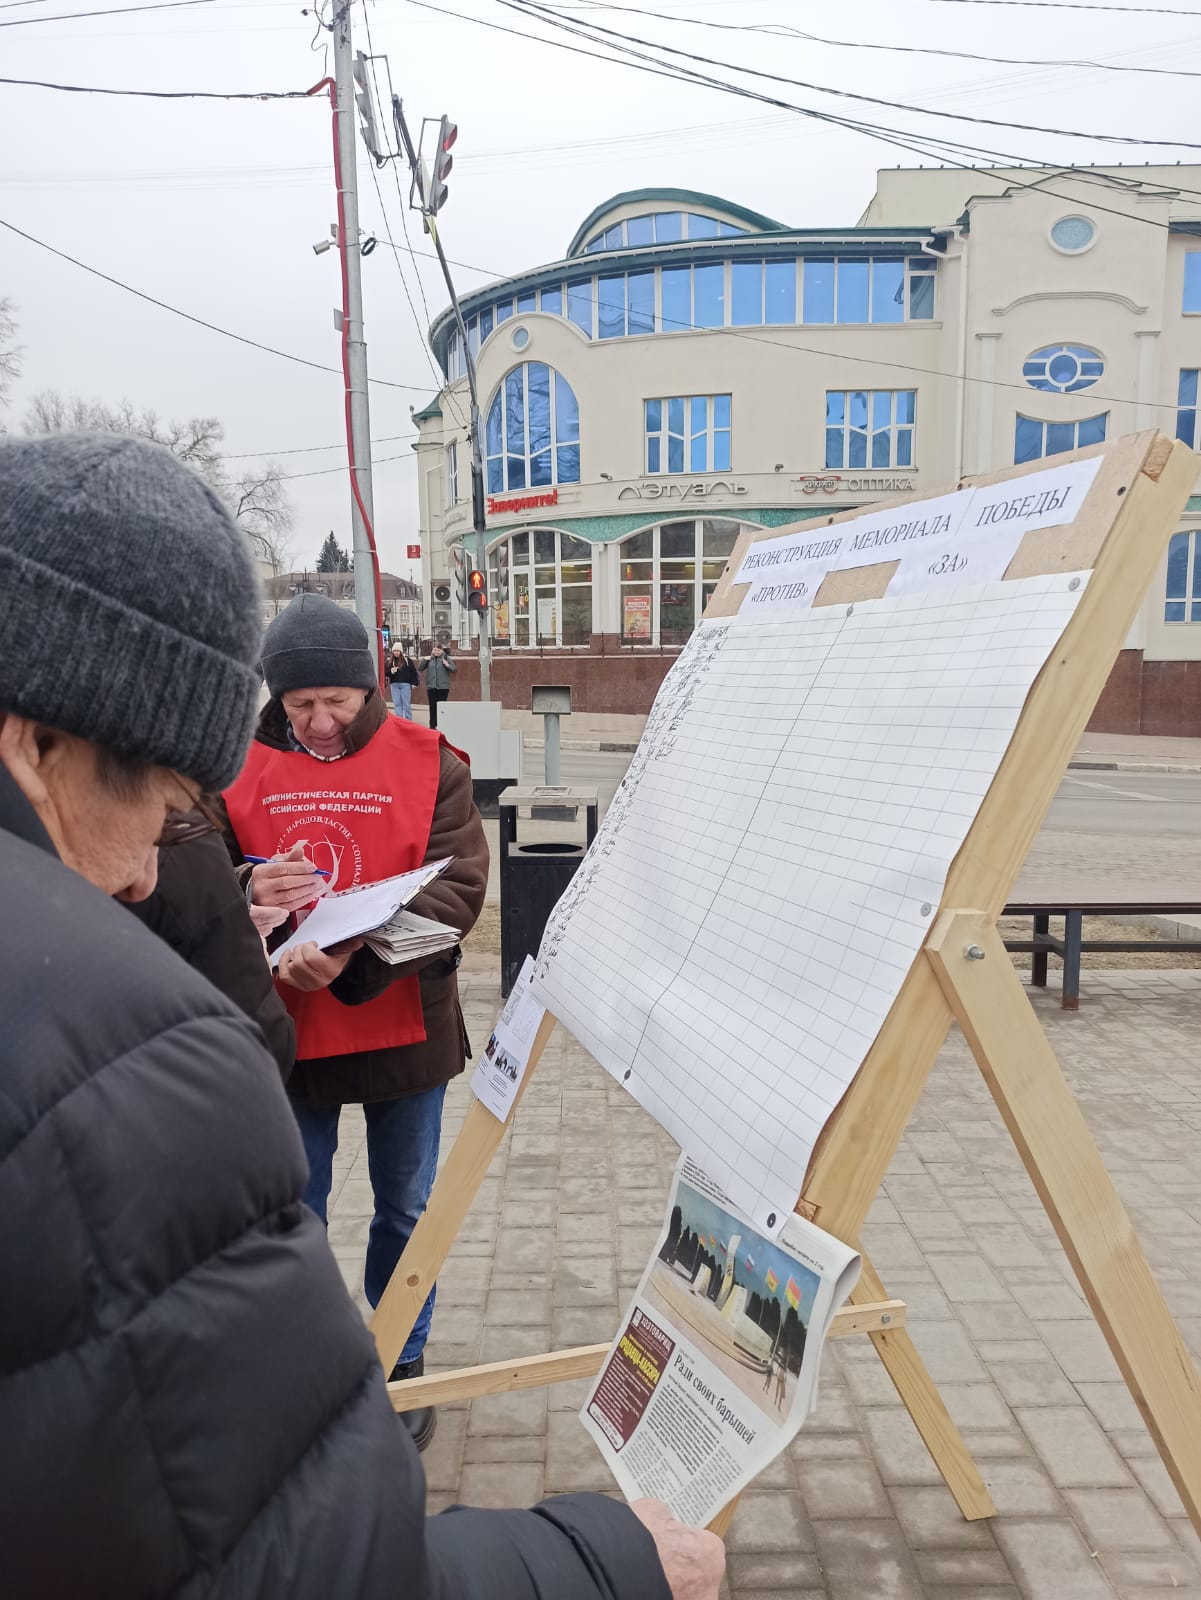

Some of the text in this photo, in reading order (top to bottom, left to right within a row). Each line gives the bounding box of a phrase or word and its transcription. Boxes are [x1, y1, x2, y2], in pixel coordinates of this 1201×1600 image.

[848, 478, 913, 491] ОПТИКА
[487, 488, 558, 515] Заверните!
[742, 486, 1072, 570] РЕКОНСТРУКЦИЯ МЕМОРИАЛА ПОБЕДЫ
[751, 552, 968, 602] «ПРОТИВ» «ЗА»
[318, 804, 382, 814] ФЕДЕРАЦИИ
[352, 791, 393, 803] ПАРТИЯ
[286, 816, 353, 840] НАРОДОВЛАСТИЕ
[673, 1354, 694, 1381] Ради
[692, 1376, 717, 1406] своих
[715, 1397, 757, 1446] барышей
